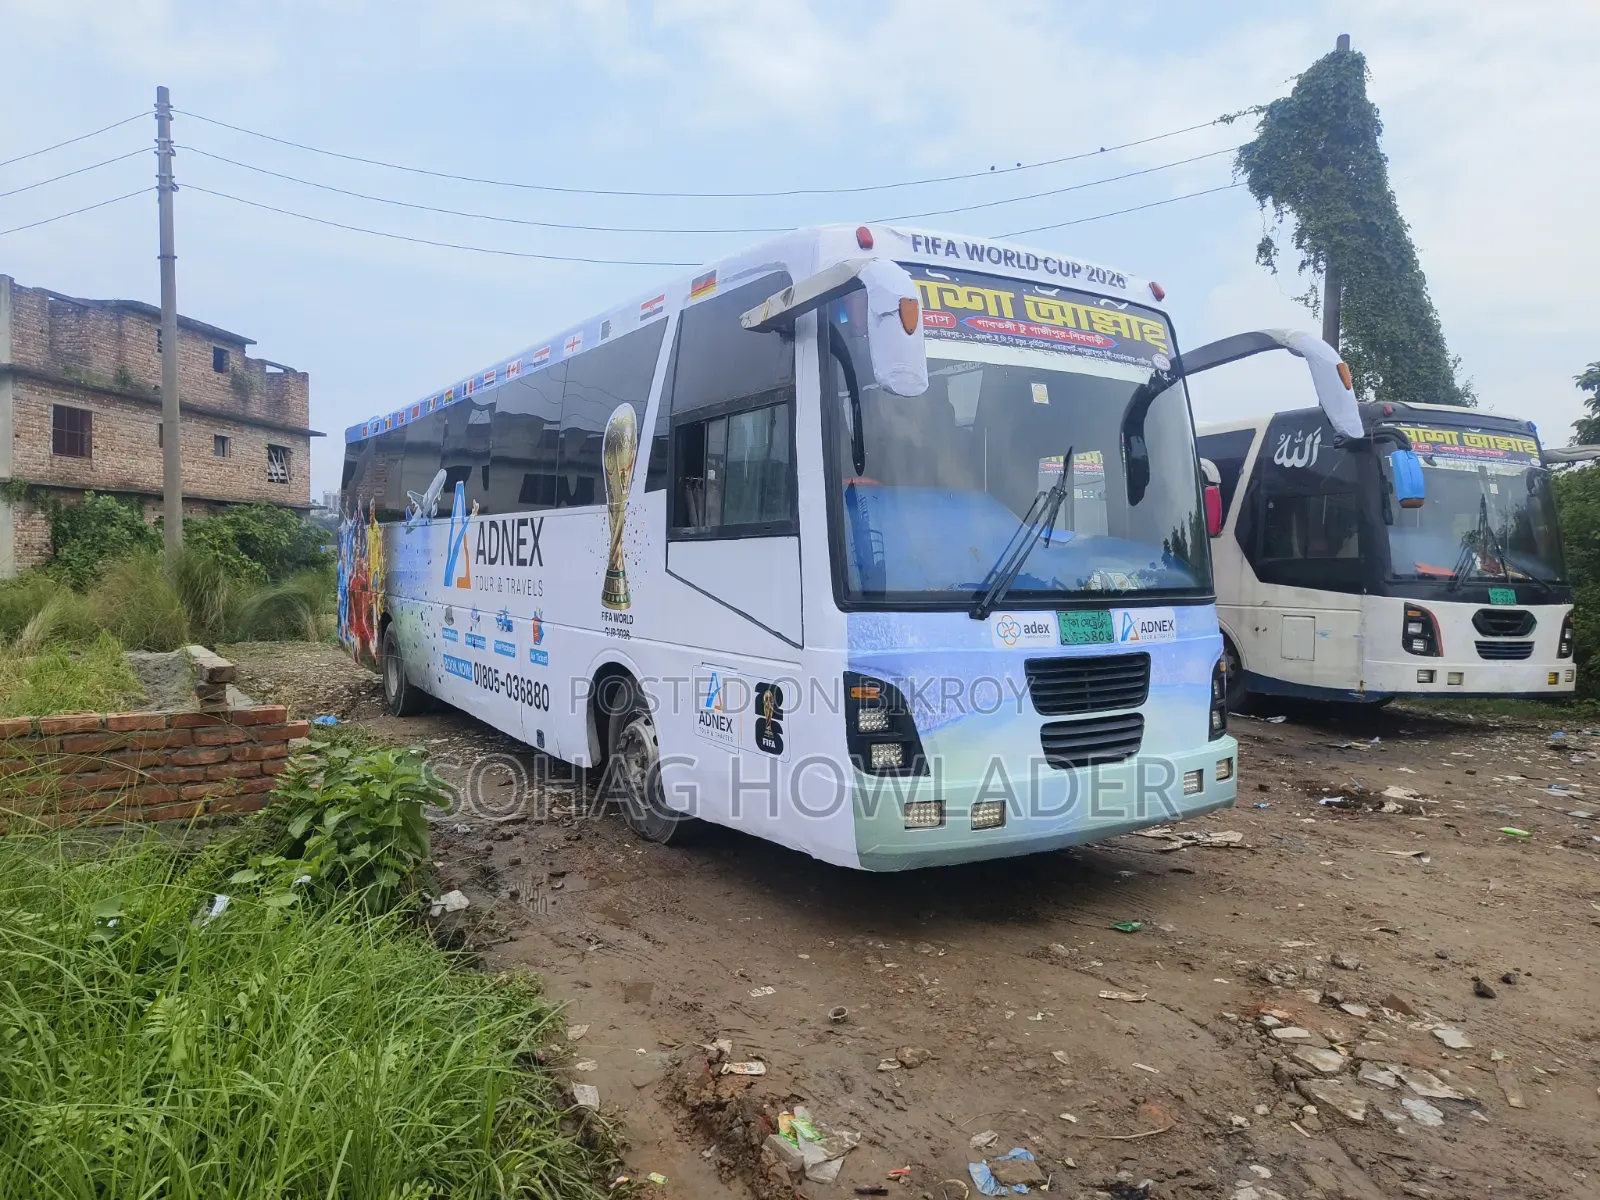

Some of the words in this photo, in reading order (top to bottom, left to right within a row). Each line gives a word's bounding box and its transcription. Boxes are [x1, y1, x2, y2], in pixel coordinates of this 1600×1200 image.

[911, 234, 960, 258] FIFA
[964, 242, 1038, 271] WORLD
[1043, 256, 1082, 279] CUP
[1085, 264, 1127, 289] 2026
[475, 516, 544, 567] ADNEX
[475, 575, 494, 591] TOUR
[497, 577, 503, 592] &
[506, 578, 544, 597] TRAVELS
[601, 611, 613, 622] FIFA
[613, 612, 634, 625] WORLD
[1023, 621, 1050, 634] adex
[1140, 619, 1175, 633] ADNEX
[474, 662, 550, 712] 01805-036880
[699, 711, 733, 734] ADNEX
[762, 738, 776, 748] FIFA
